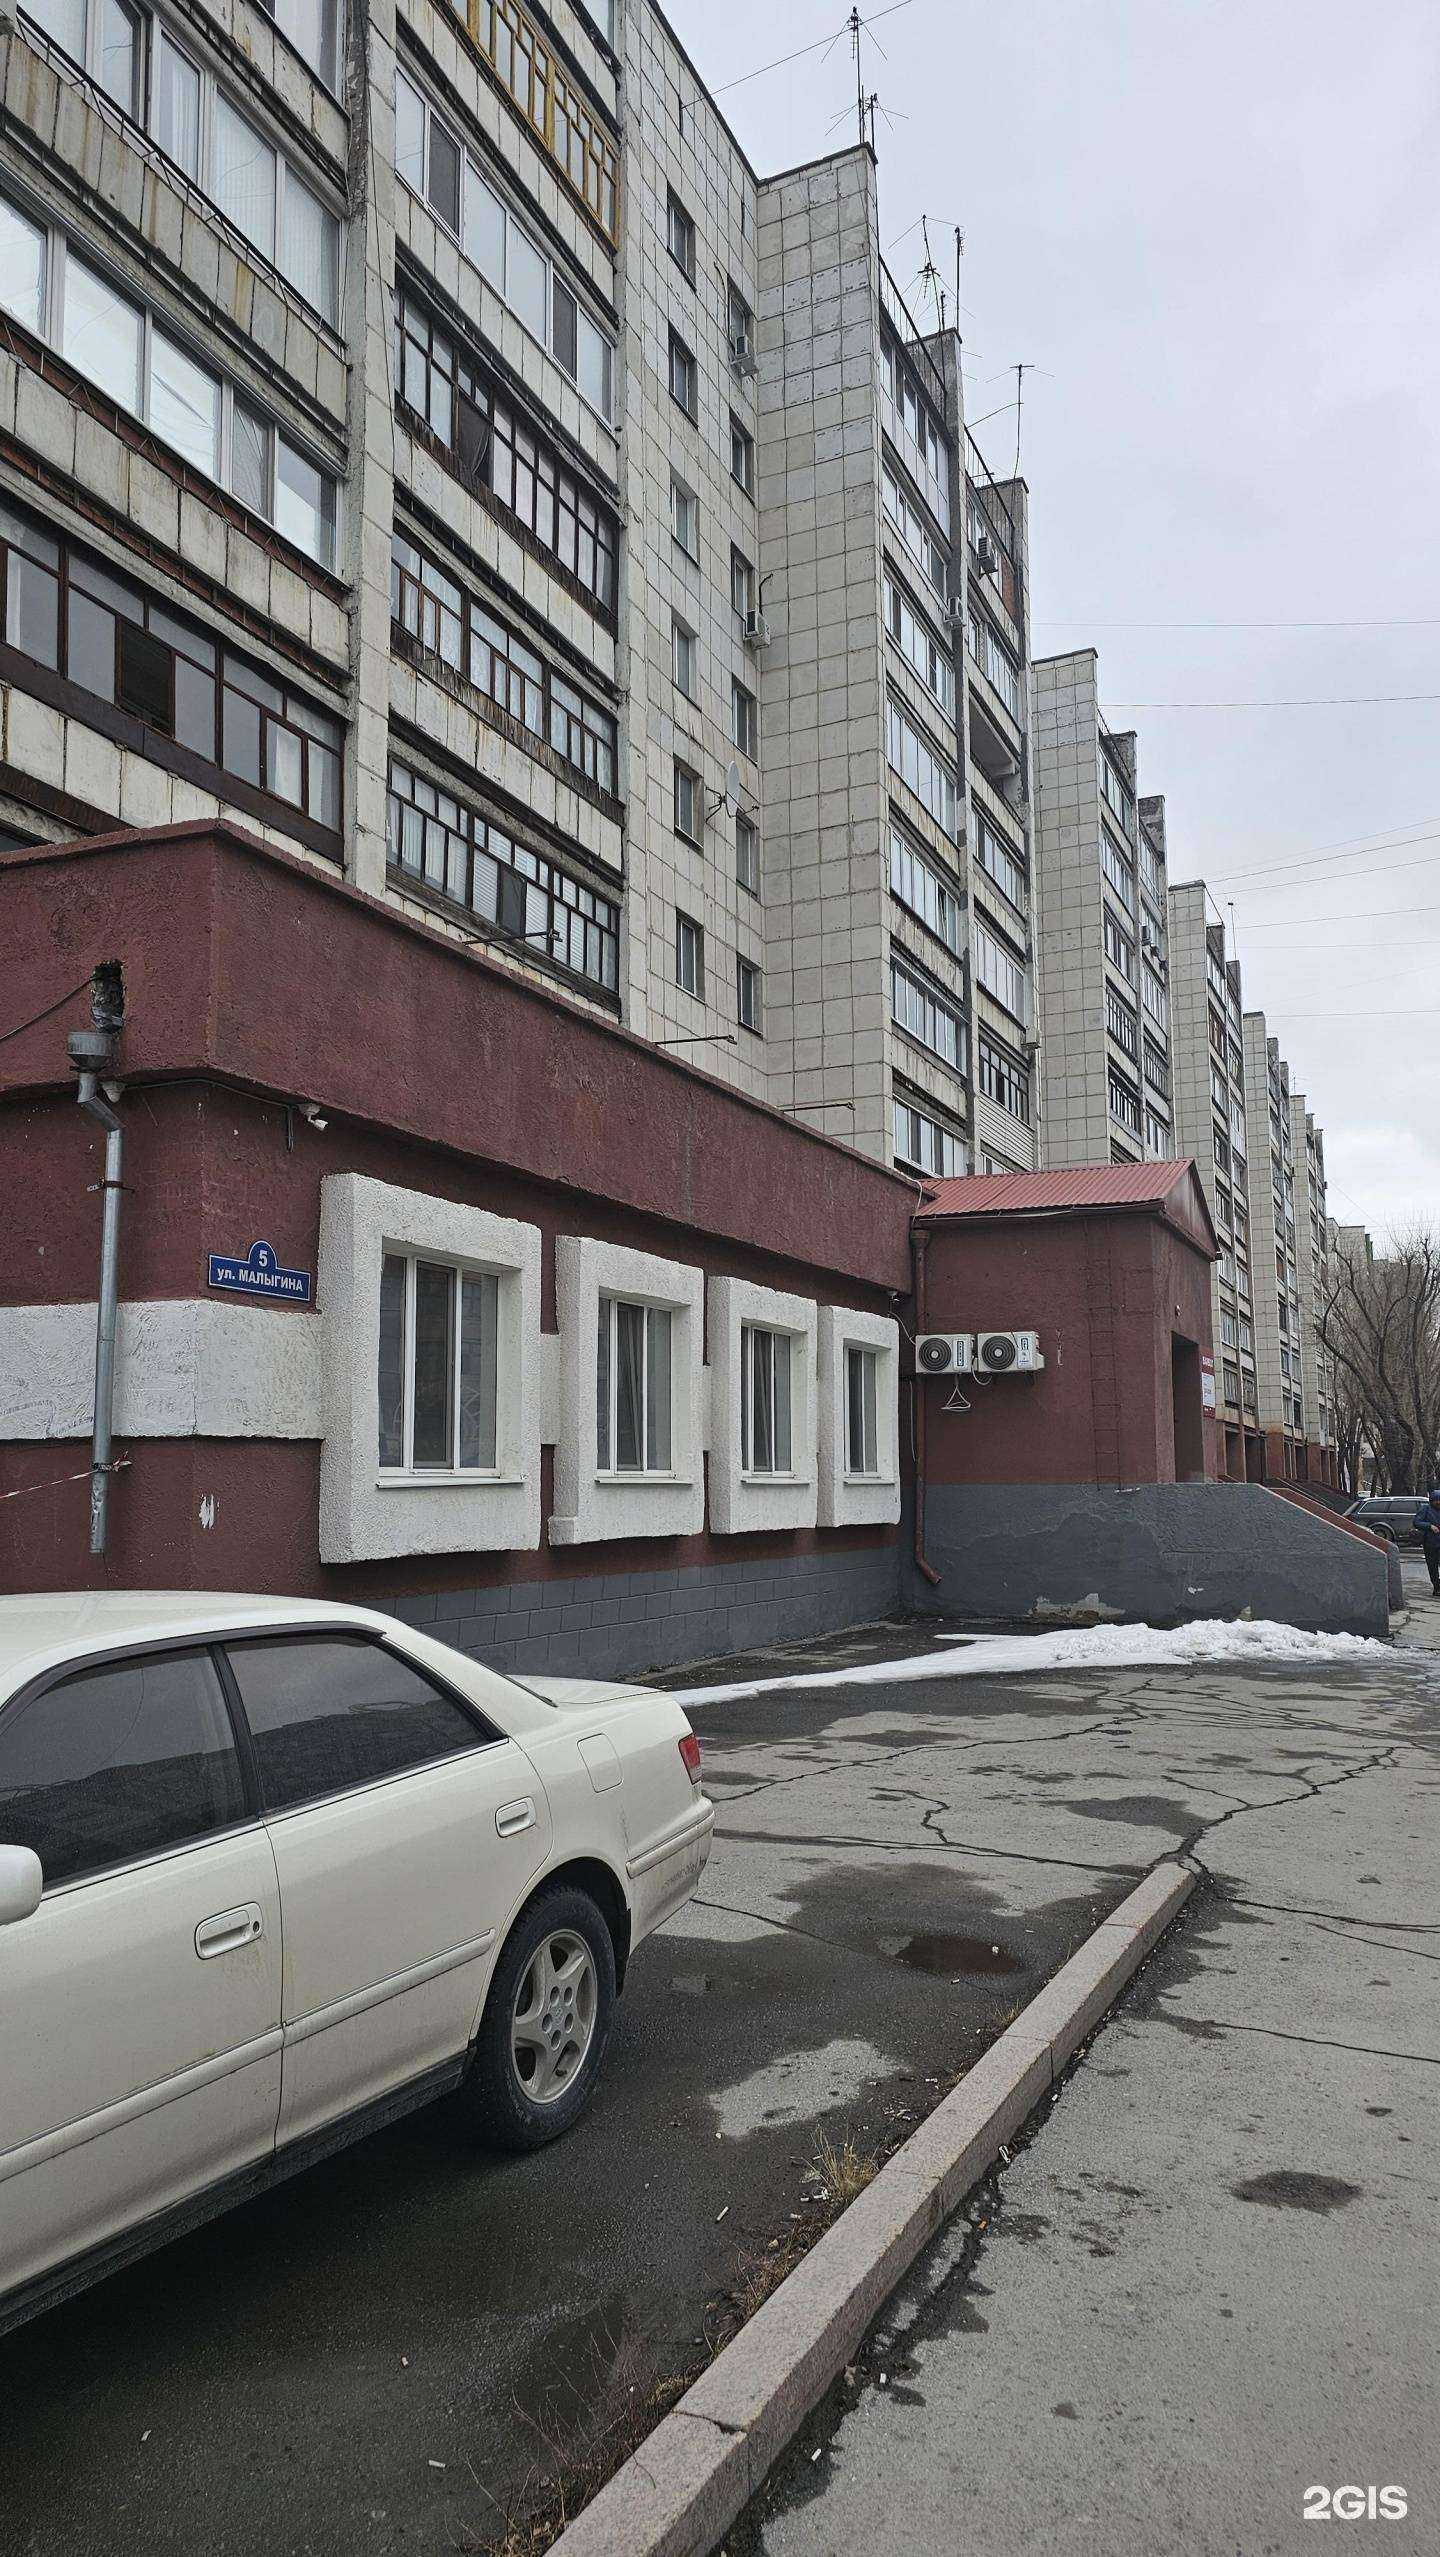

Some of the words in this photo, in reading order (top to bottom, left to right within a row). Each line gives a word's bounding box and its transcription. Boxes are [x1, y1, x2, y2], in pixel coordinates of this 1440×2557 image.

[258, 1249, 268, 1267] 5
[217, 1268, 236, 1280] ул.
[238, 1268, 304, 1292] МАЛЫГИНА
